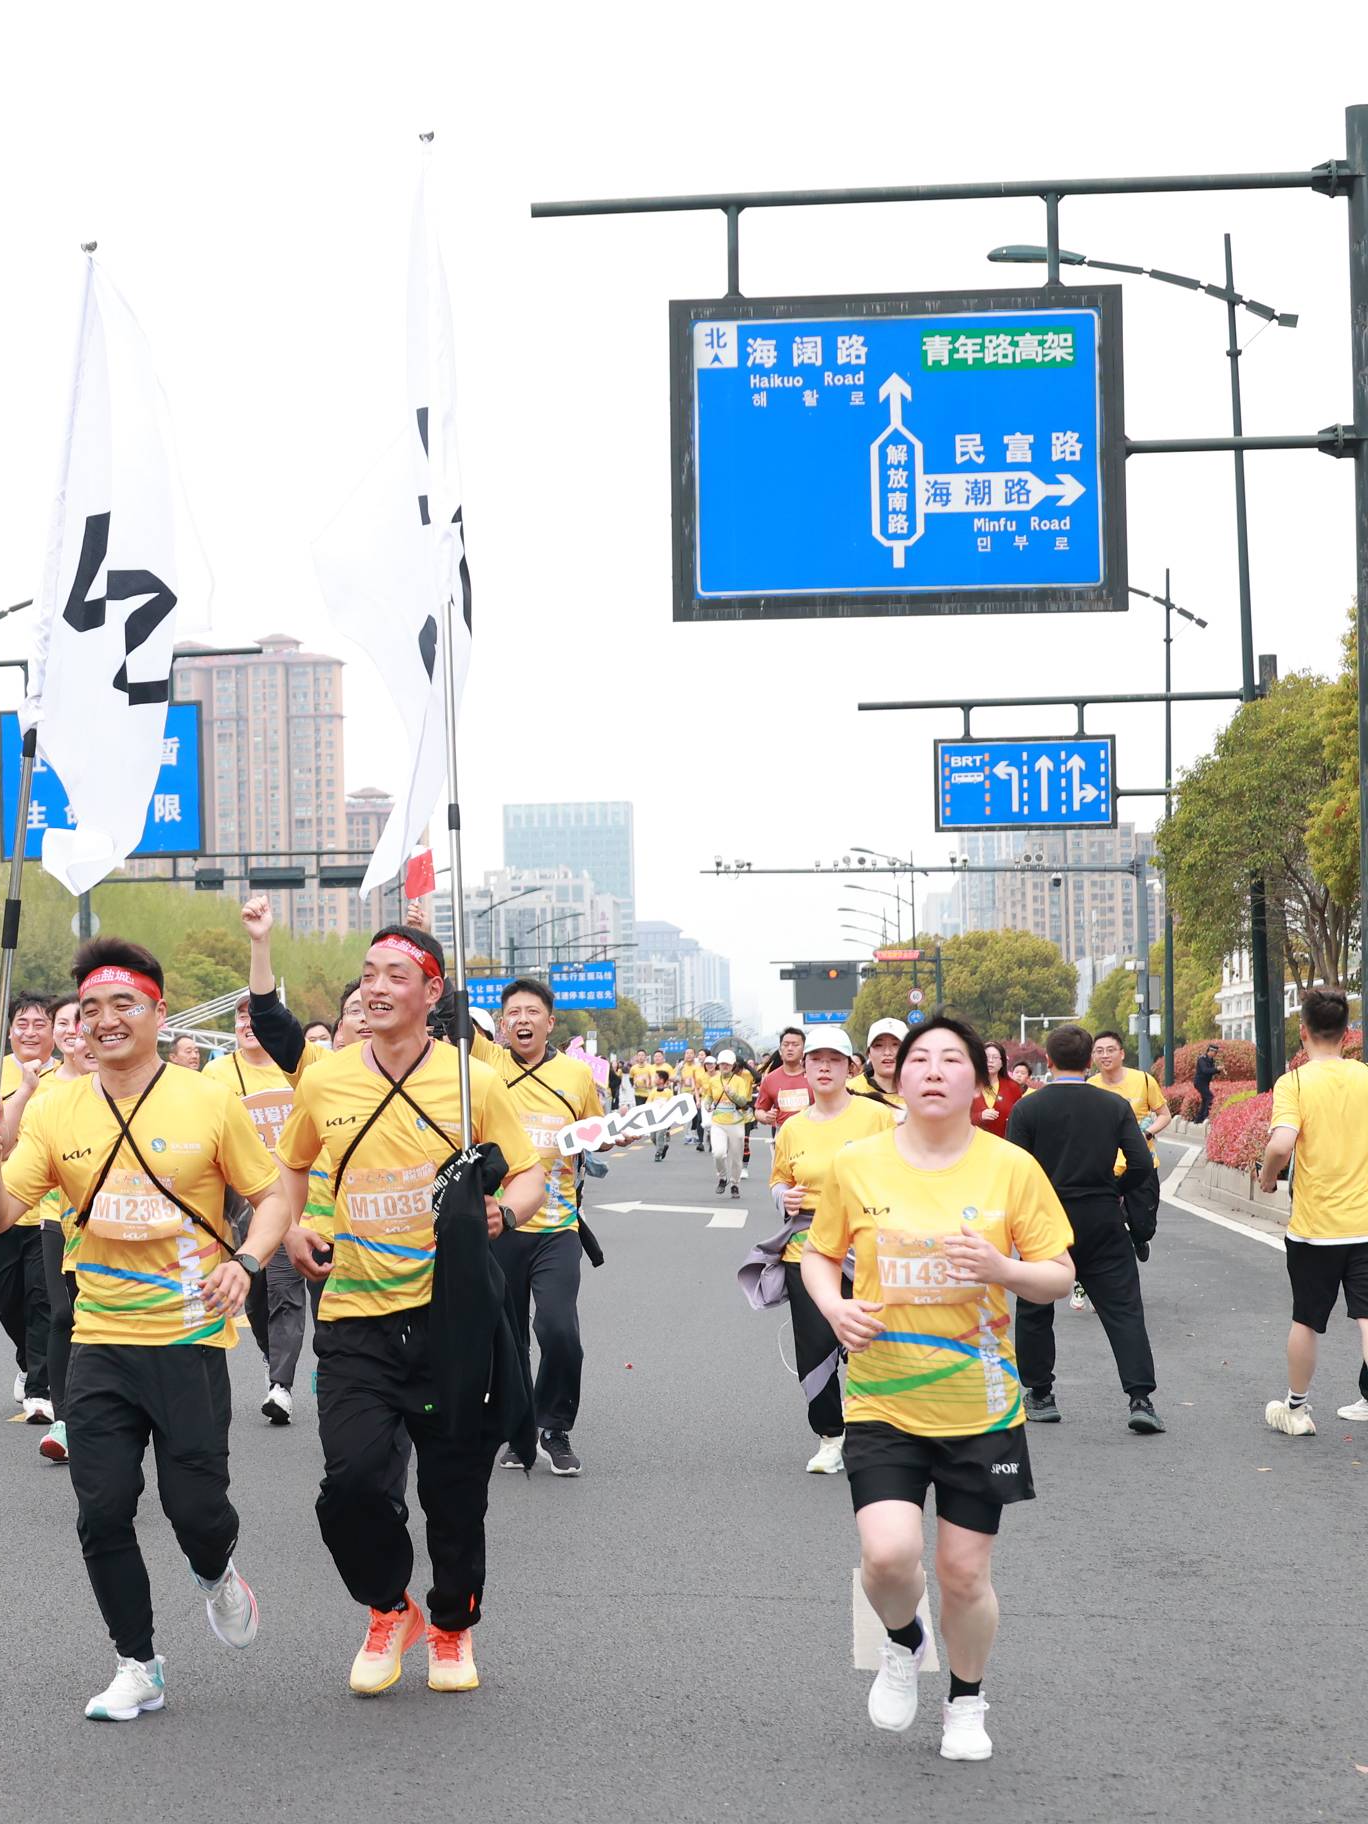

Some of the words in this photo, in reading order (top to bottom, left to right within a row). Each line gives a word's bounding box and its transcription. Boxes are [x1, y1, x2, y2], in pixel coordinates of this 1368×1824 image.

[704, 327, 727, 349] 北
[747, 334, 868, 368] 海阔路
[922, 331, 1074, 367] 青年路高架
[750, 373, 803, 389] Haikuo
[824, 371, 865, 387] Road
[954, 431, 1083, 465] 民富路
[886, 444, 909, 535] 解放南路
[924, 478, 1032, 508] 海潮路
[973, 516, 1016, 532] Minfu
[1030, 515, 1071, 531] Road
[950, 755, 983, 767] BRT
[94, 1195, 176, 1222] M12385
[350, 1191, 432, 1219] M1035
[991, 1462, 1020, 1474] SPOR
